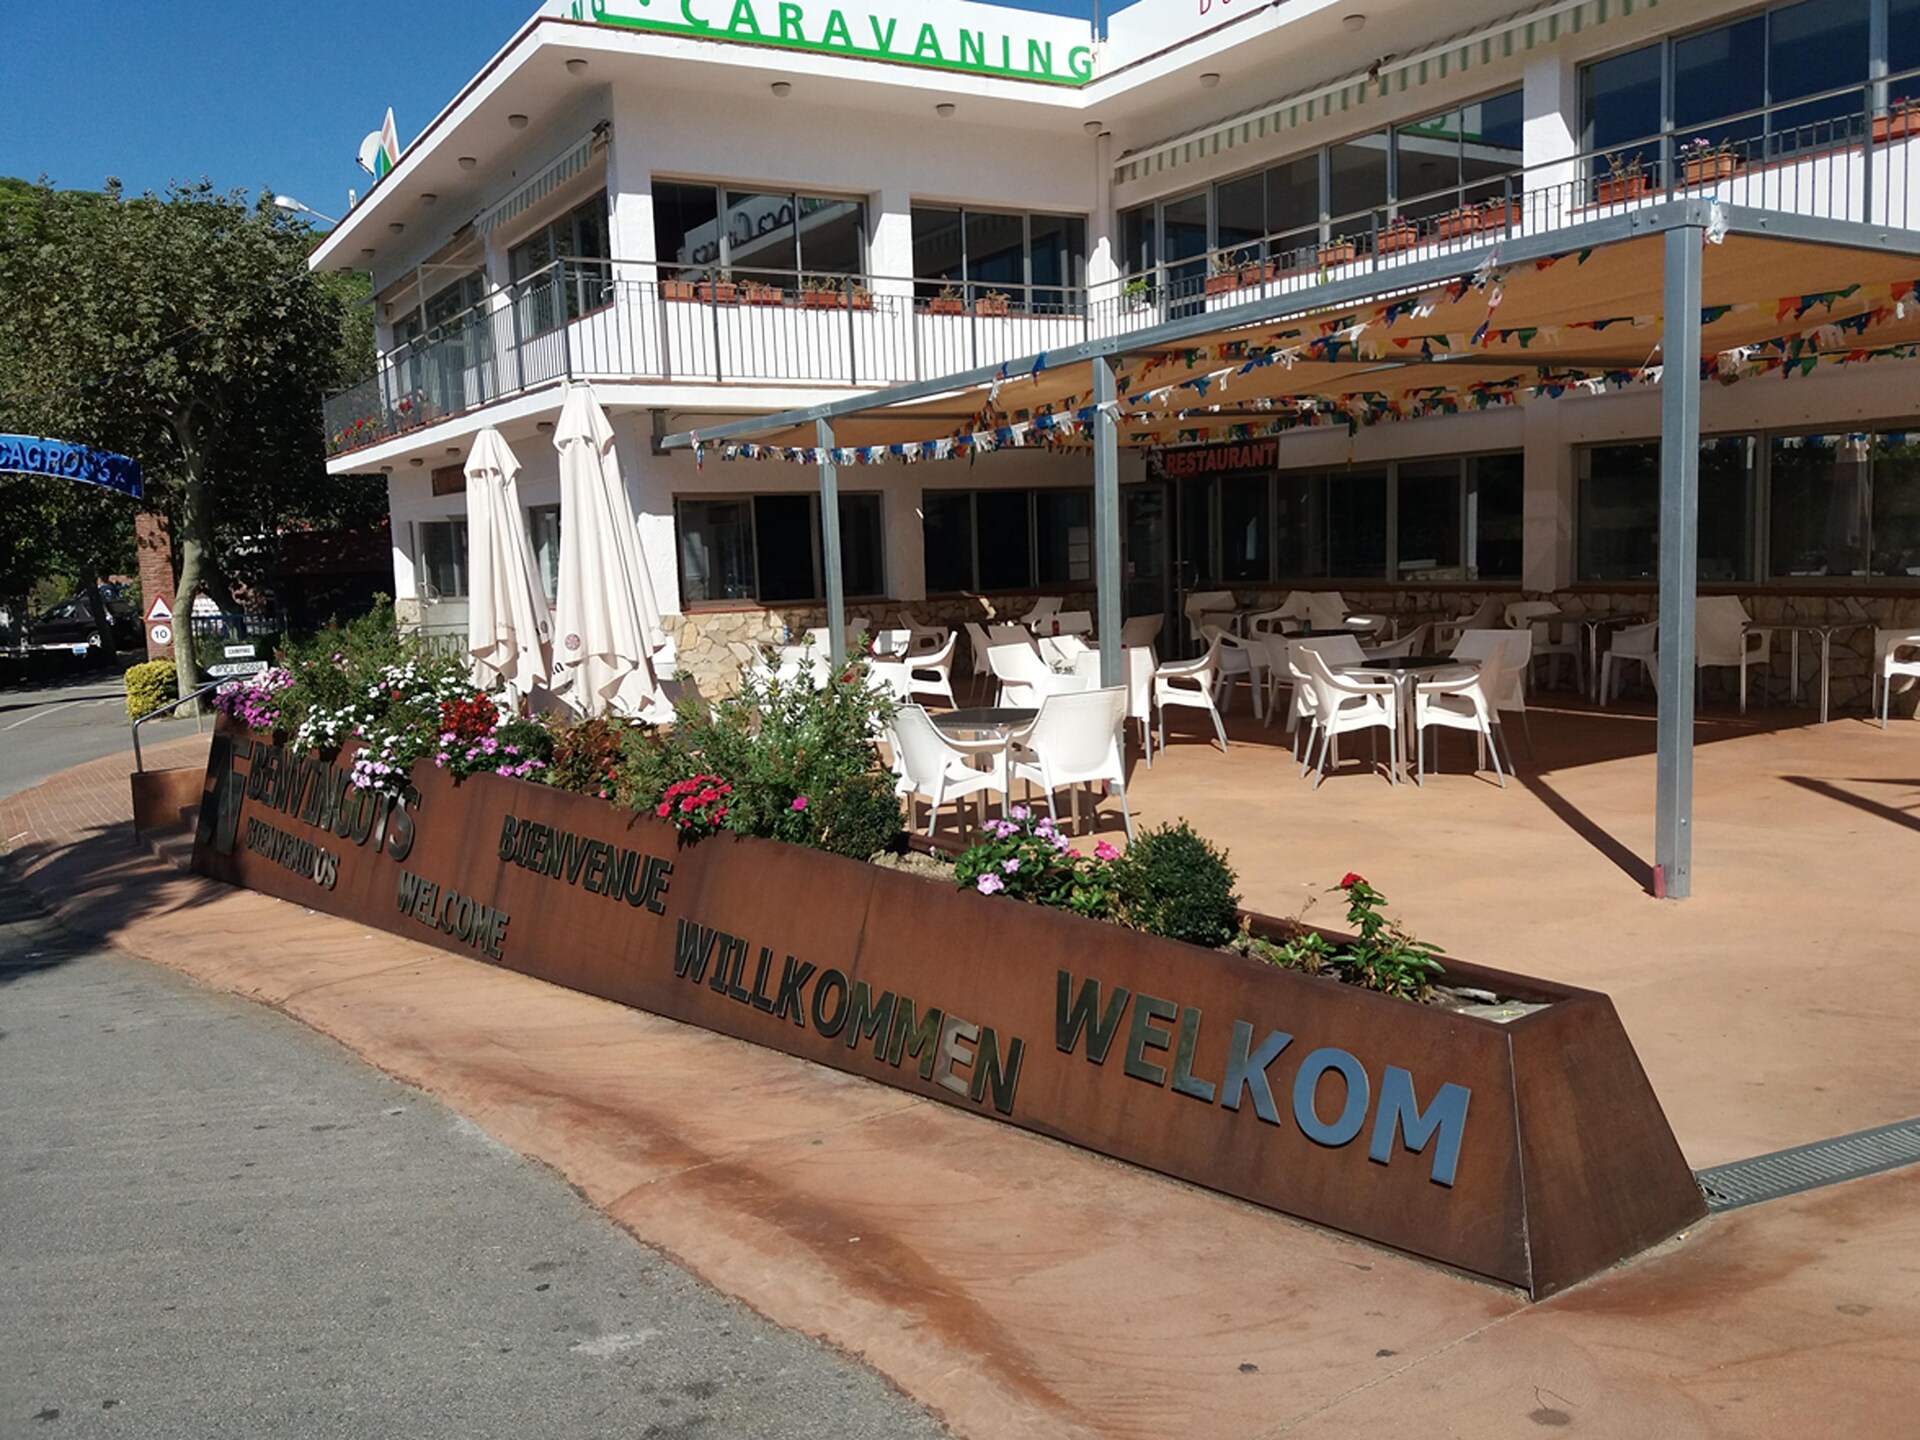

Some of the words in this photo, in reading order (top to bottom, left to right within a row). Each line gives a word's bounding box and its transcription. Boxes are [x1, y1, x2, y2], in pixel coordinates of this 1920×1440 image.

[681, 0, 1092, 79] CARAVANING
[1166, 442, 1278, 474] RESTAURANT
[154, 629, 168, 639] 10
[247, 816, 340, 890] BIENVENIDOS
[499, 814, 673, 914] BIENVENUE
[399, 870, 510, 959] WELCOME
[674, 919, 1025, 1114] WILLKOMMEN
[1056, 969, 1471, 1188] WELKOM
